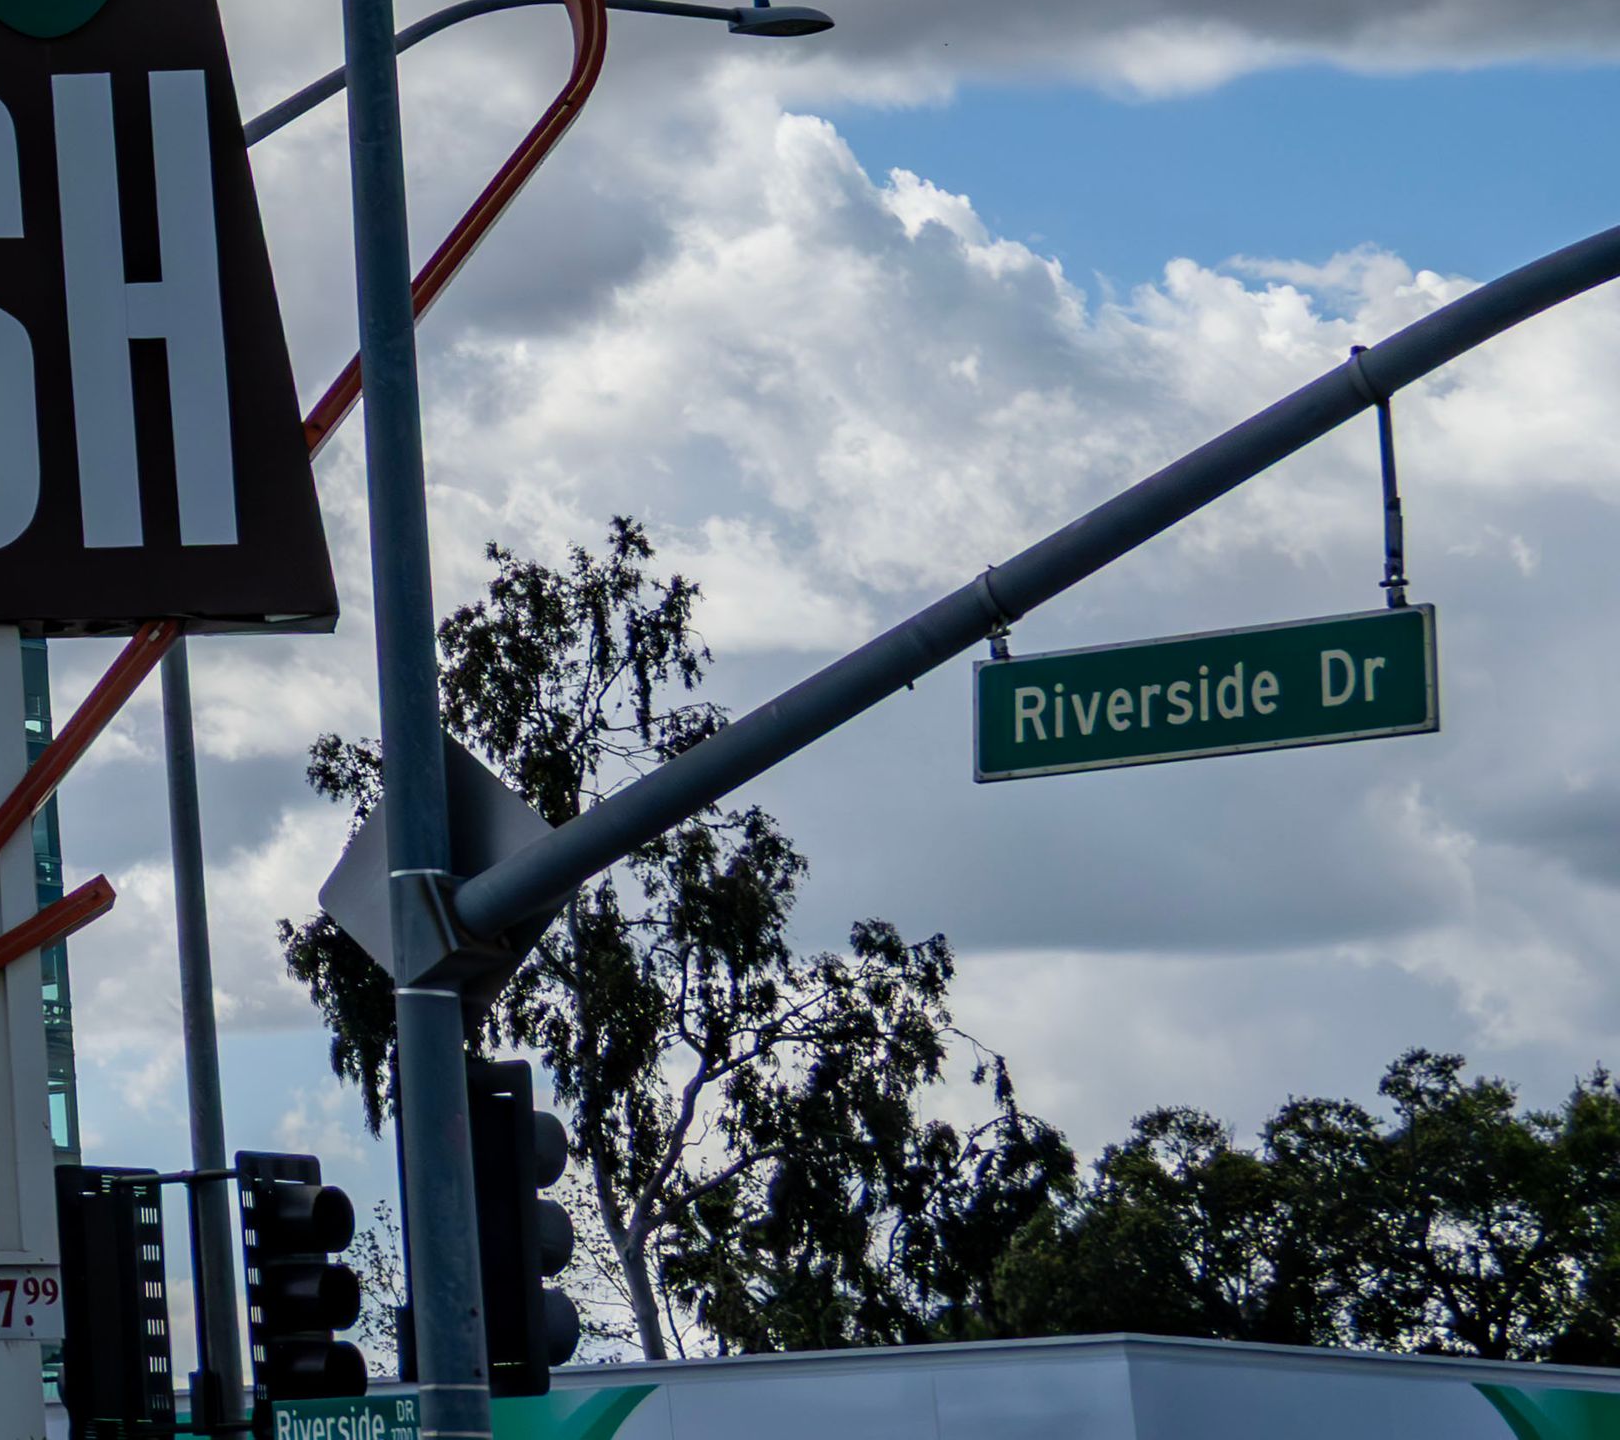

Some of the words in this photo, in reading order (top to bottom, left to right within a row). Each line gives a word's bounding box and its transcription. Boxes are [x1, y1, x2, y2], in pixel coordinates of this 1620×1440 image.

[1014, 661, 1280, 743] Riverside
[1321, 648, 1386, 708] Dr
[276, 1406, 385, 1440] Riverside
[396, 1400, 415, 1422] DR
